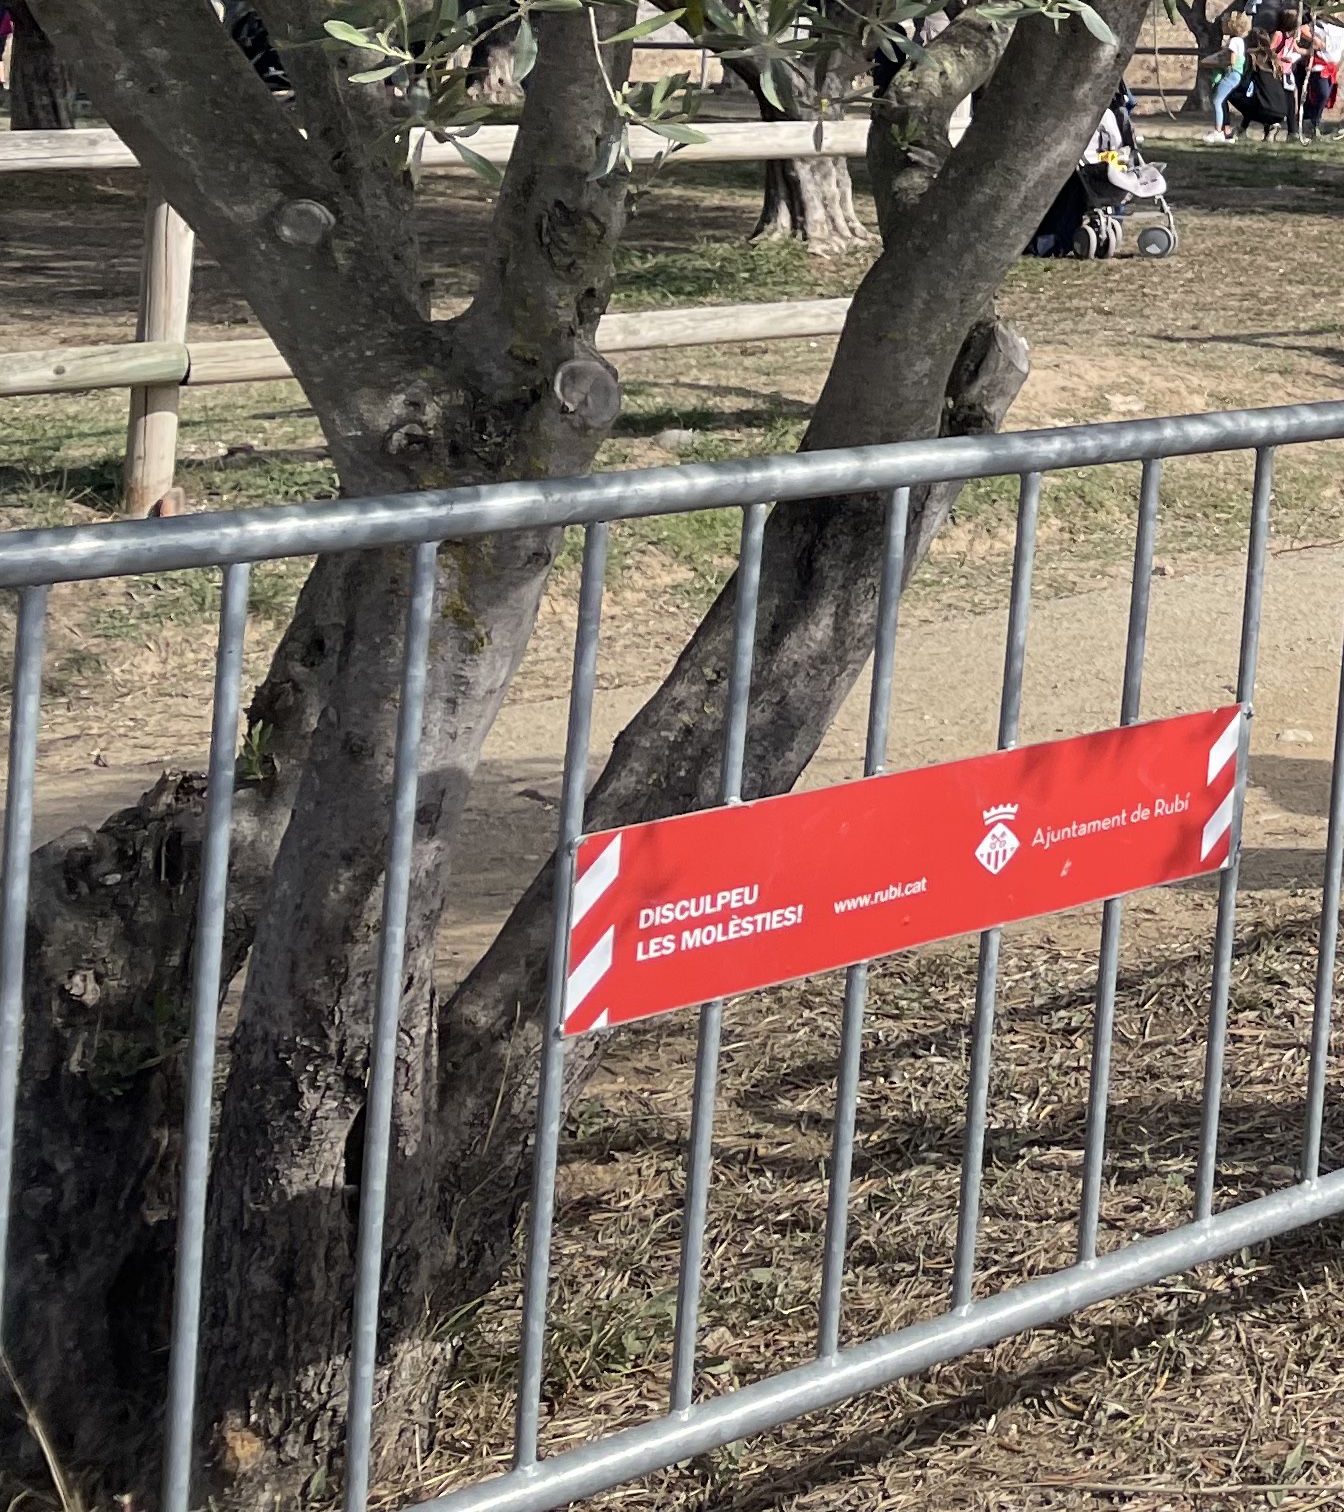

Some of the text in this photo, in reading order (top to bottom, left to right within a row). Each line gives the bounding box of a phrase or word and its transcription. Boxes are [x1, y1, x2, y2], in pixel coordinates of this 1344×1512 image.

[1032, 792, 1191, 850] Ajuntament de Rubí
[635, 904, 804, 962] LES MOLÈSTIES!
[638, 884, 760, 930] DISCULPEU
